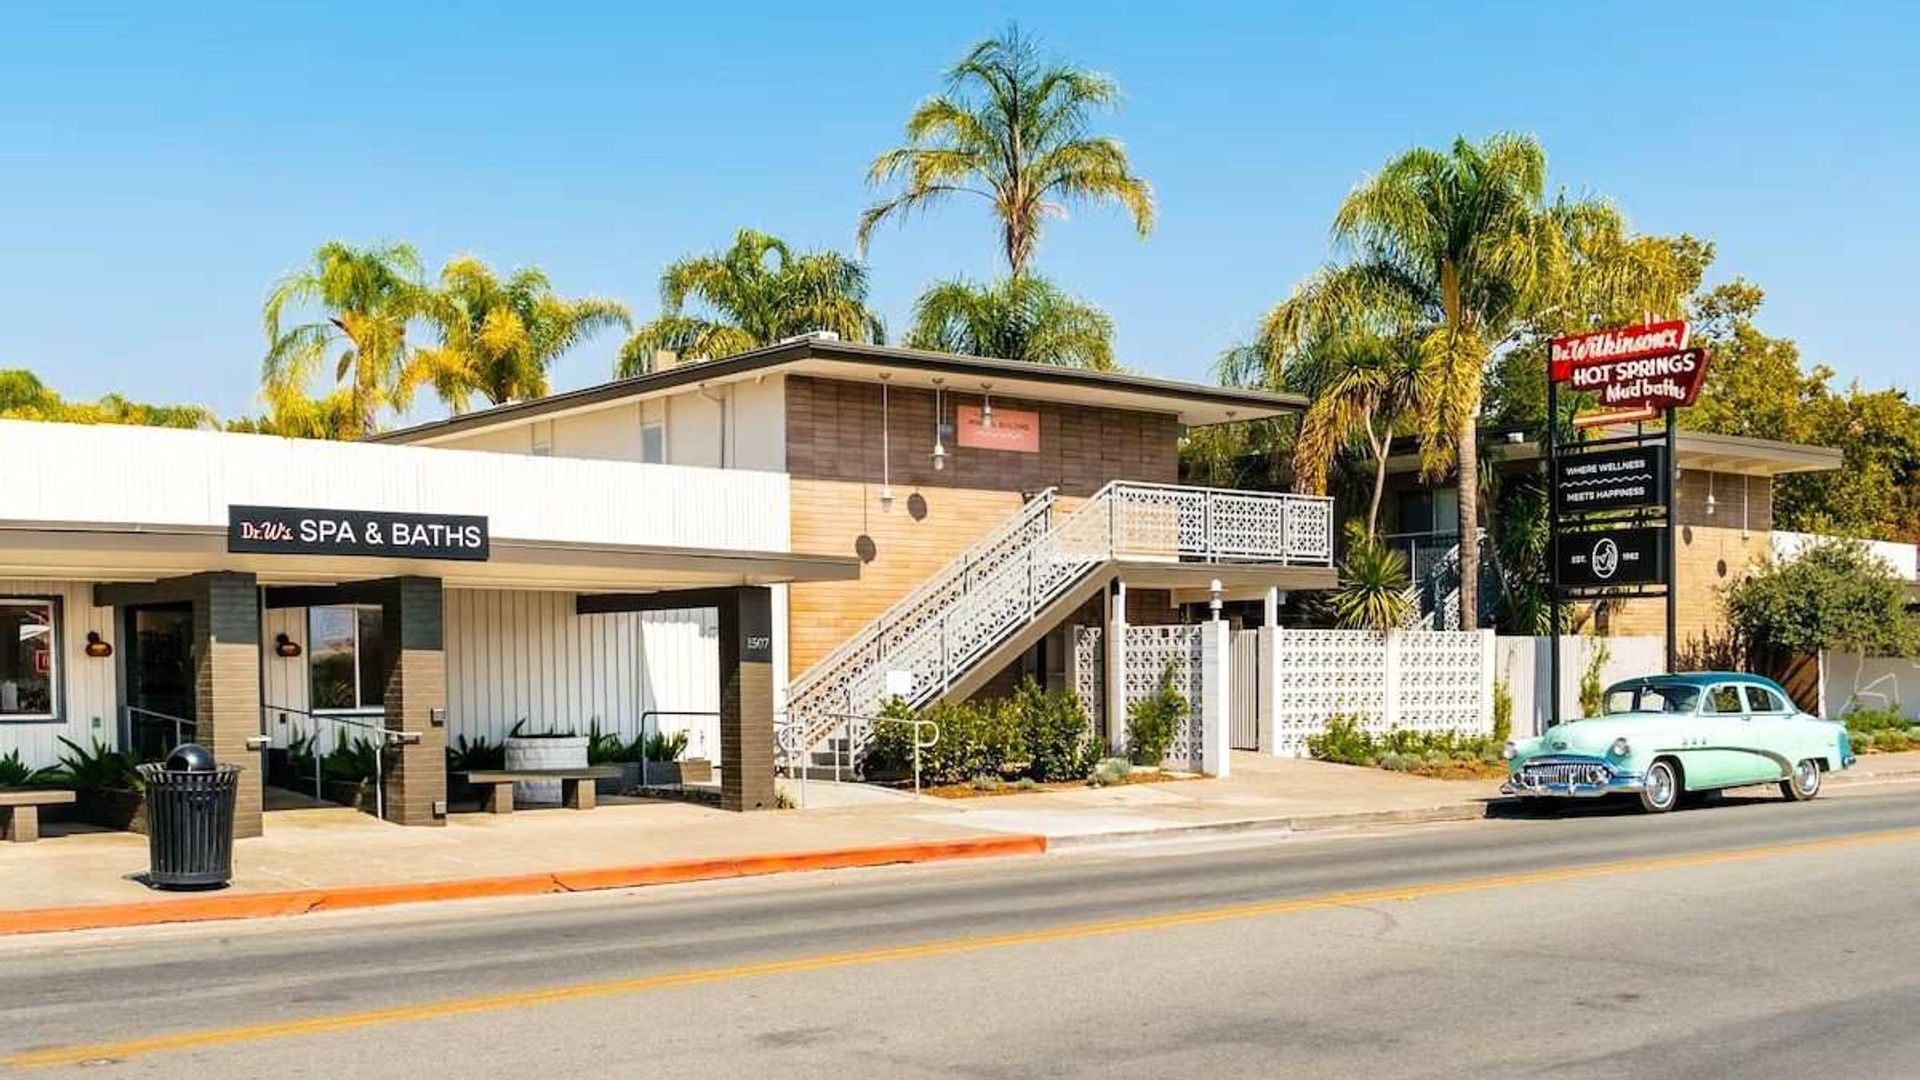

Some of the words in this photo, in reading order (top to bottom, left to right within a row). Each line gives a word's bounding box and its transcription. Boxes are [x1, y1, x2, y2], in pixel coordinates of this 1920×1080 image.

[1573, 365, 1614, 386] HOT
[1616, 352, 1696, 380] SPRINGS
[1565, 464, 1597, 476] WHERE
[1598, 460, 1646, 472] WELLNESS
[1566, 491, 1595, 502] MEETS
[1596, 486, 1645, 499] HAPPINESS
[300, 519, 356, 544] SPA
[365, 521, 384, 545] &
[391, 522, 482, 548] BATHS
